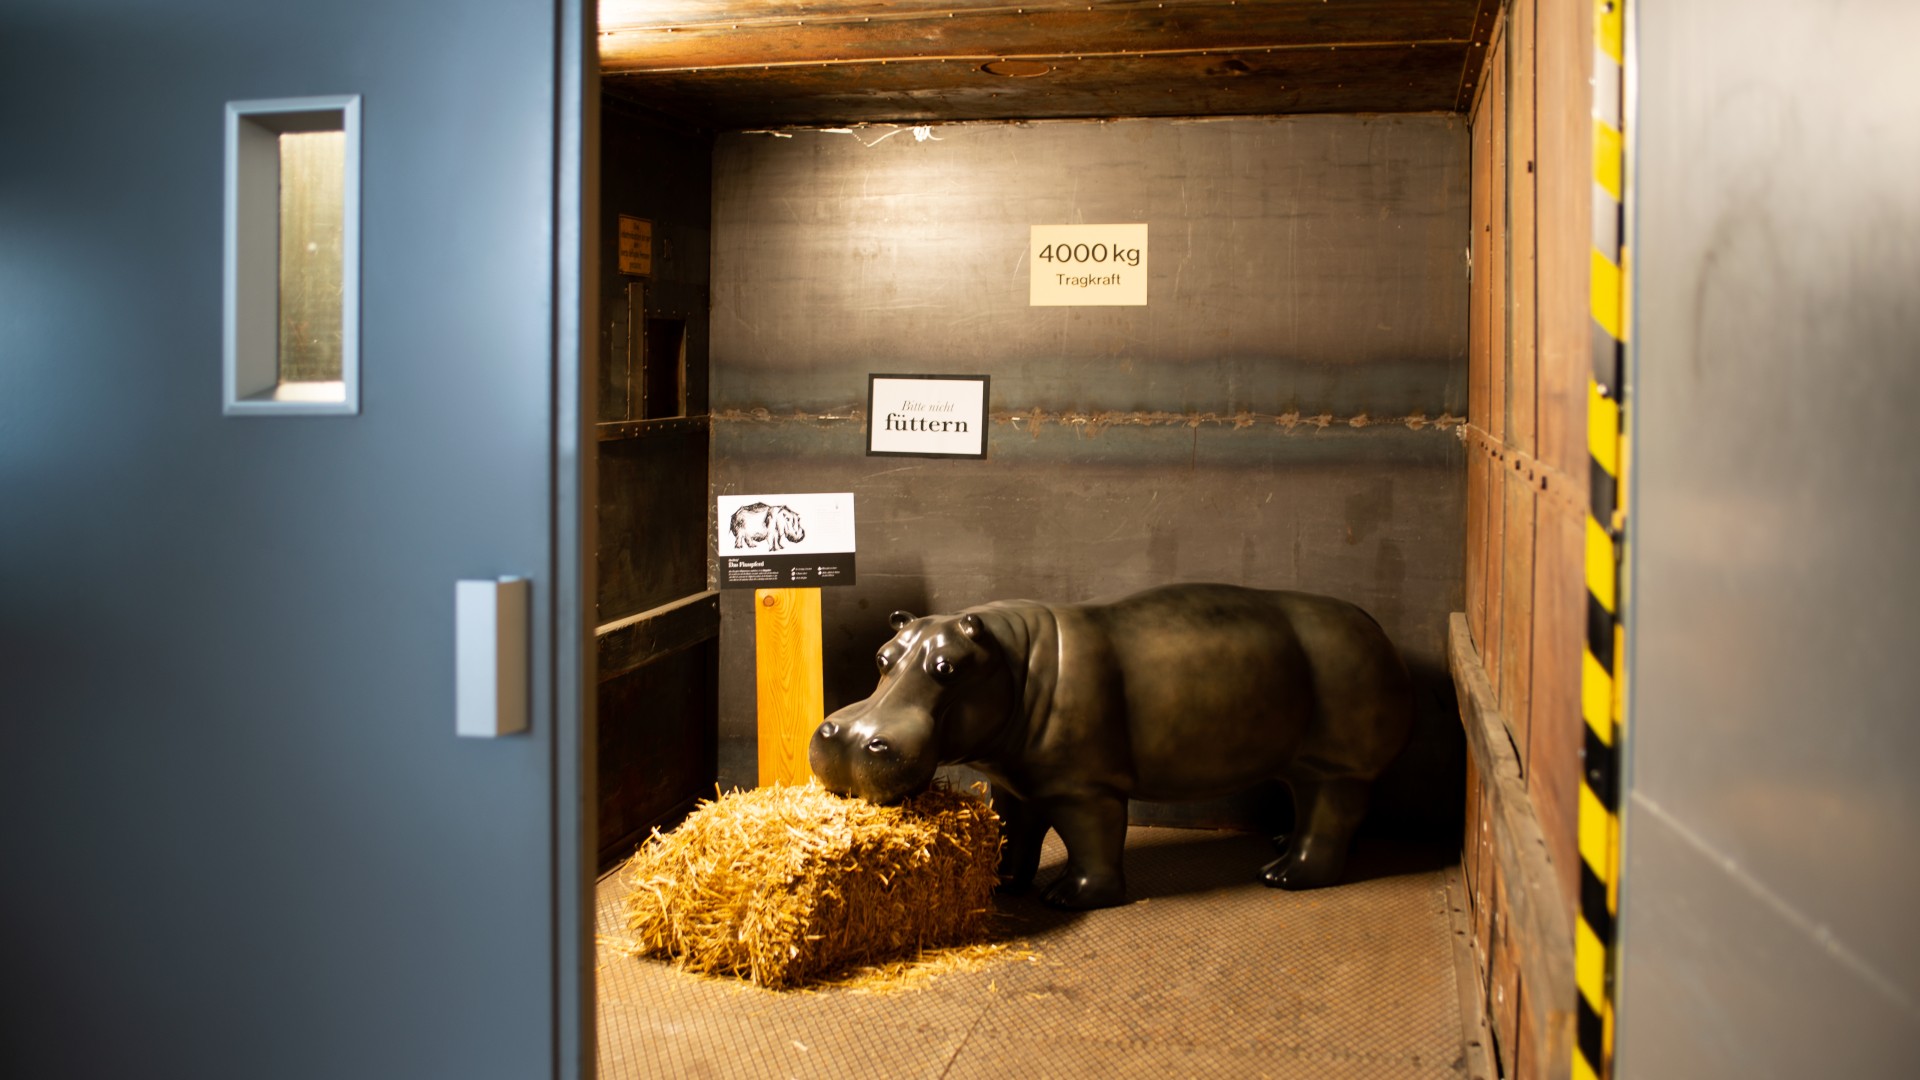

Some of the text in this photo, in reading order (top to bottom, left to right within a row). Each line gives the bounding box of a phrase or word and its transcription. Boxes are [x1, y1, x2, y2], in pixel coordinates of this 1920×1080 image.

[1039, 243, 1140, 267] 4000 kg
[1056, 273, 1120, 288] Tragkraft
[902, 400, 955, 412] Bitte nicht
[885, 412, 968, 432] füttern
